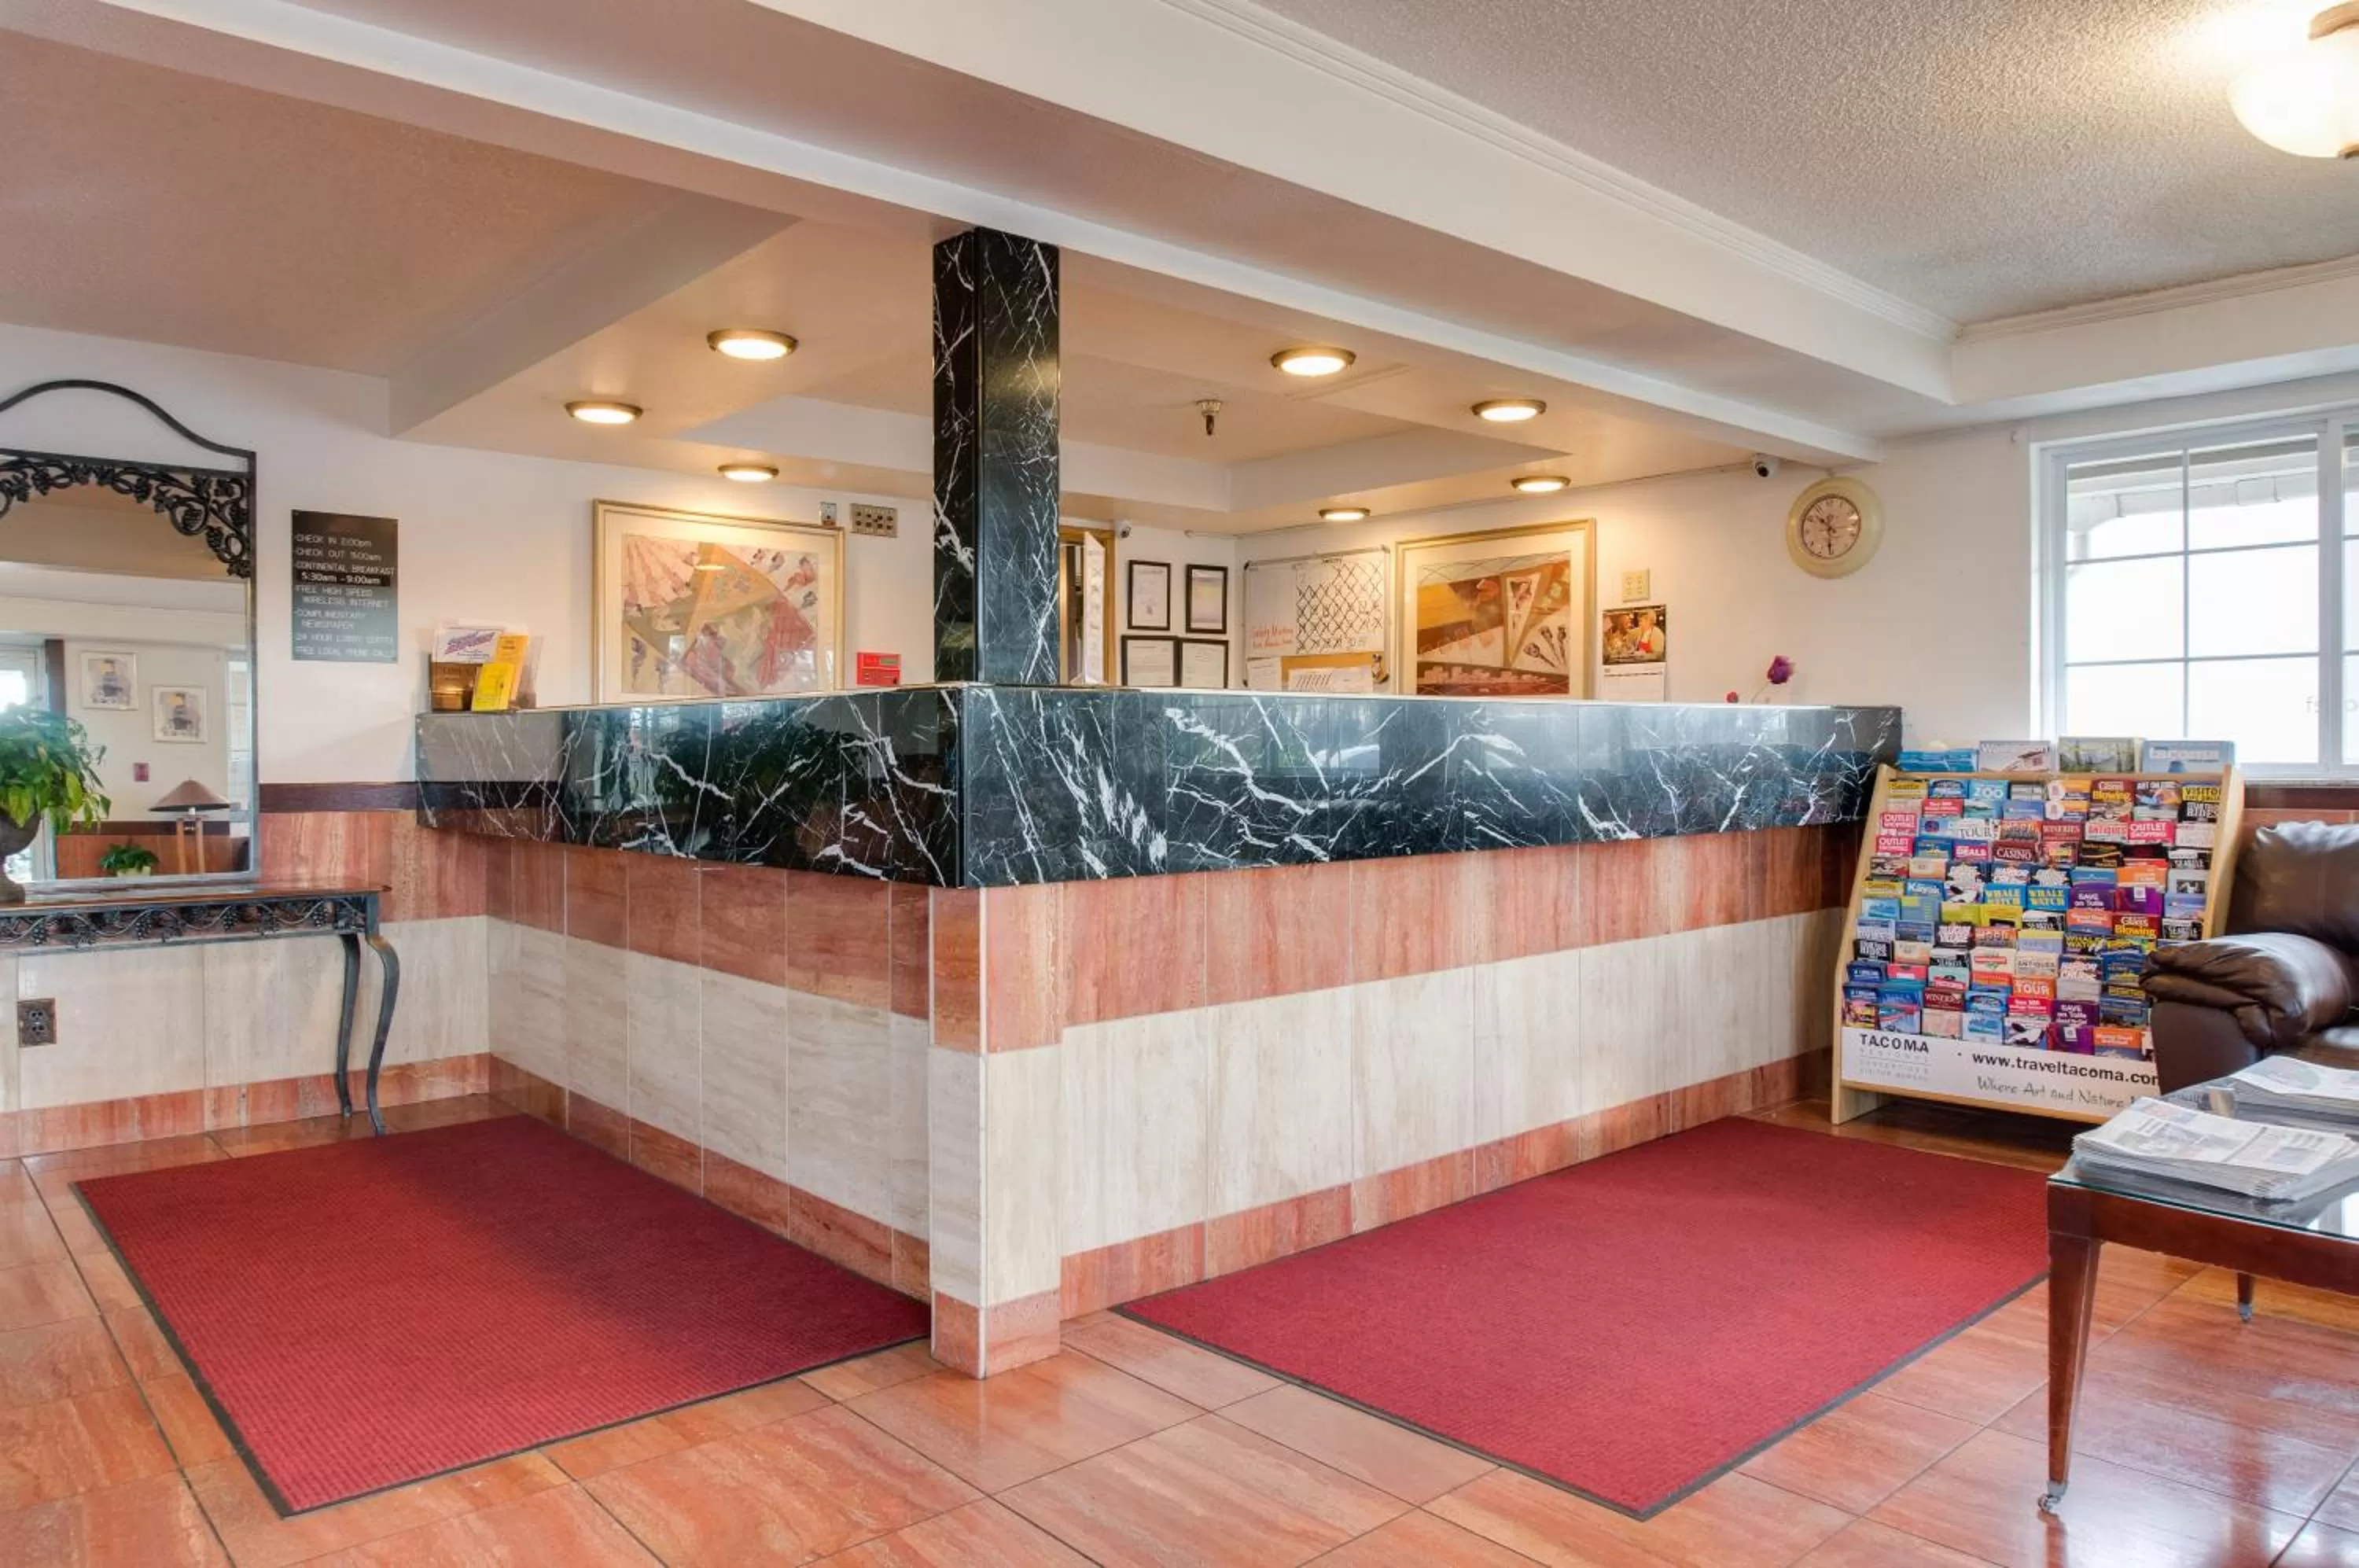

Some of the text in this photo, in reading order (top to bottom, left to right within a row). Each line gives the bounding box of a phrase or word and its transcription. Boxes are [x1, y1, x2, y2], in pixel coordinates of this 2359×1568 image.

[328, 549, 346, 559] OUT
[1974, 787, 2004, 798] ZOO
[2183, 787, 2221, 796] VISITO
[2130, 823, 2166, 831] OUTLET
[1997, 849, 2033, 861] CASINO
[2031, 897, 2065, 906] WATCH
[2016, 984, 2050, 995] TOUR
[1859, 1033, 1929, 1053] TACOMA
[1977, 1075, 2125, 1108] Where Art and Nature
